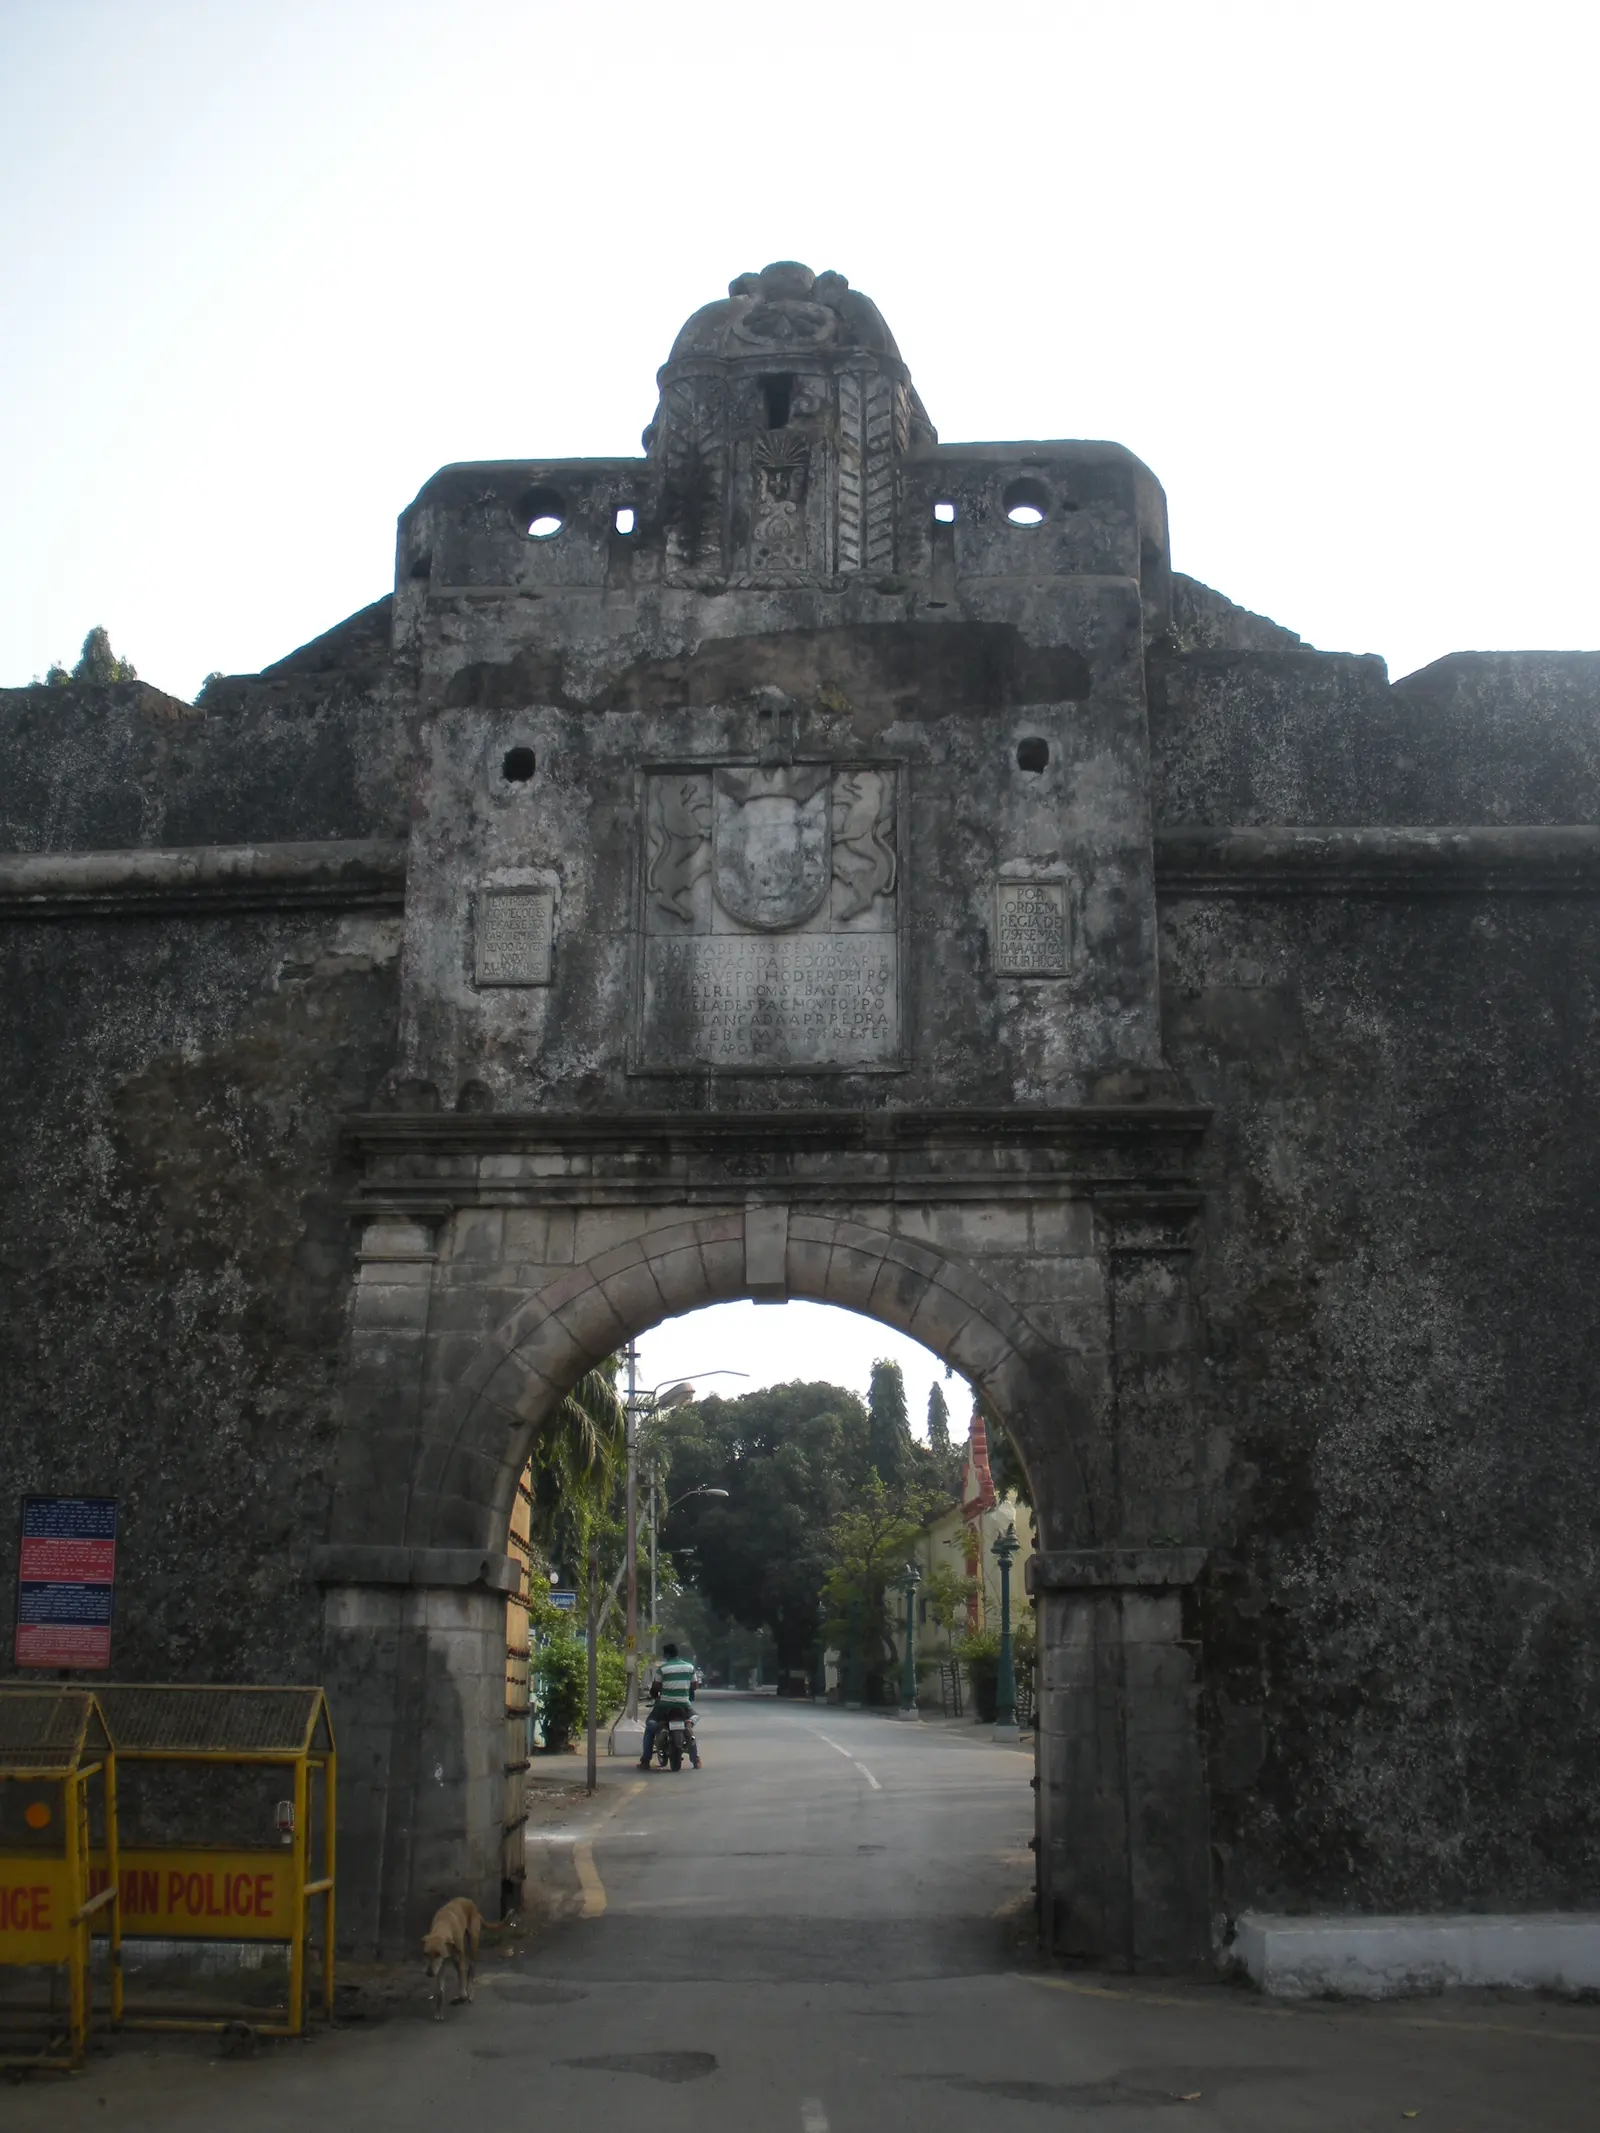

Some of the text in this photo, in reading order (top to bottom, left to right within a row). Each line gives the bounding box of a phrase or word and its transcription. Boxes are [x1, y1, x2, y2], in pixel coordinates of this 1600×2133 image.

[1017, 888, 1044, 901] POR
[1005, 901, 1060, 915] ORDEM
[168, 1871, 274, 1918] POLICE
